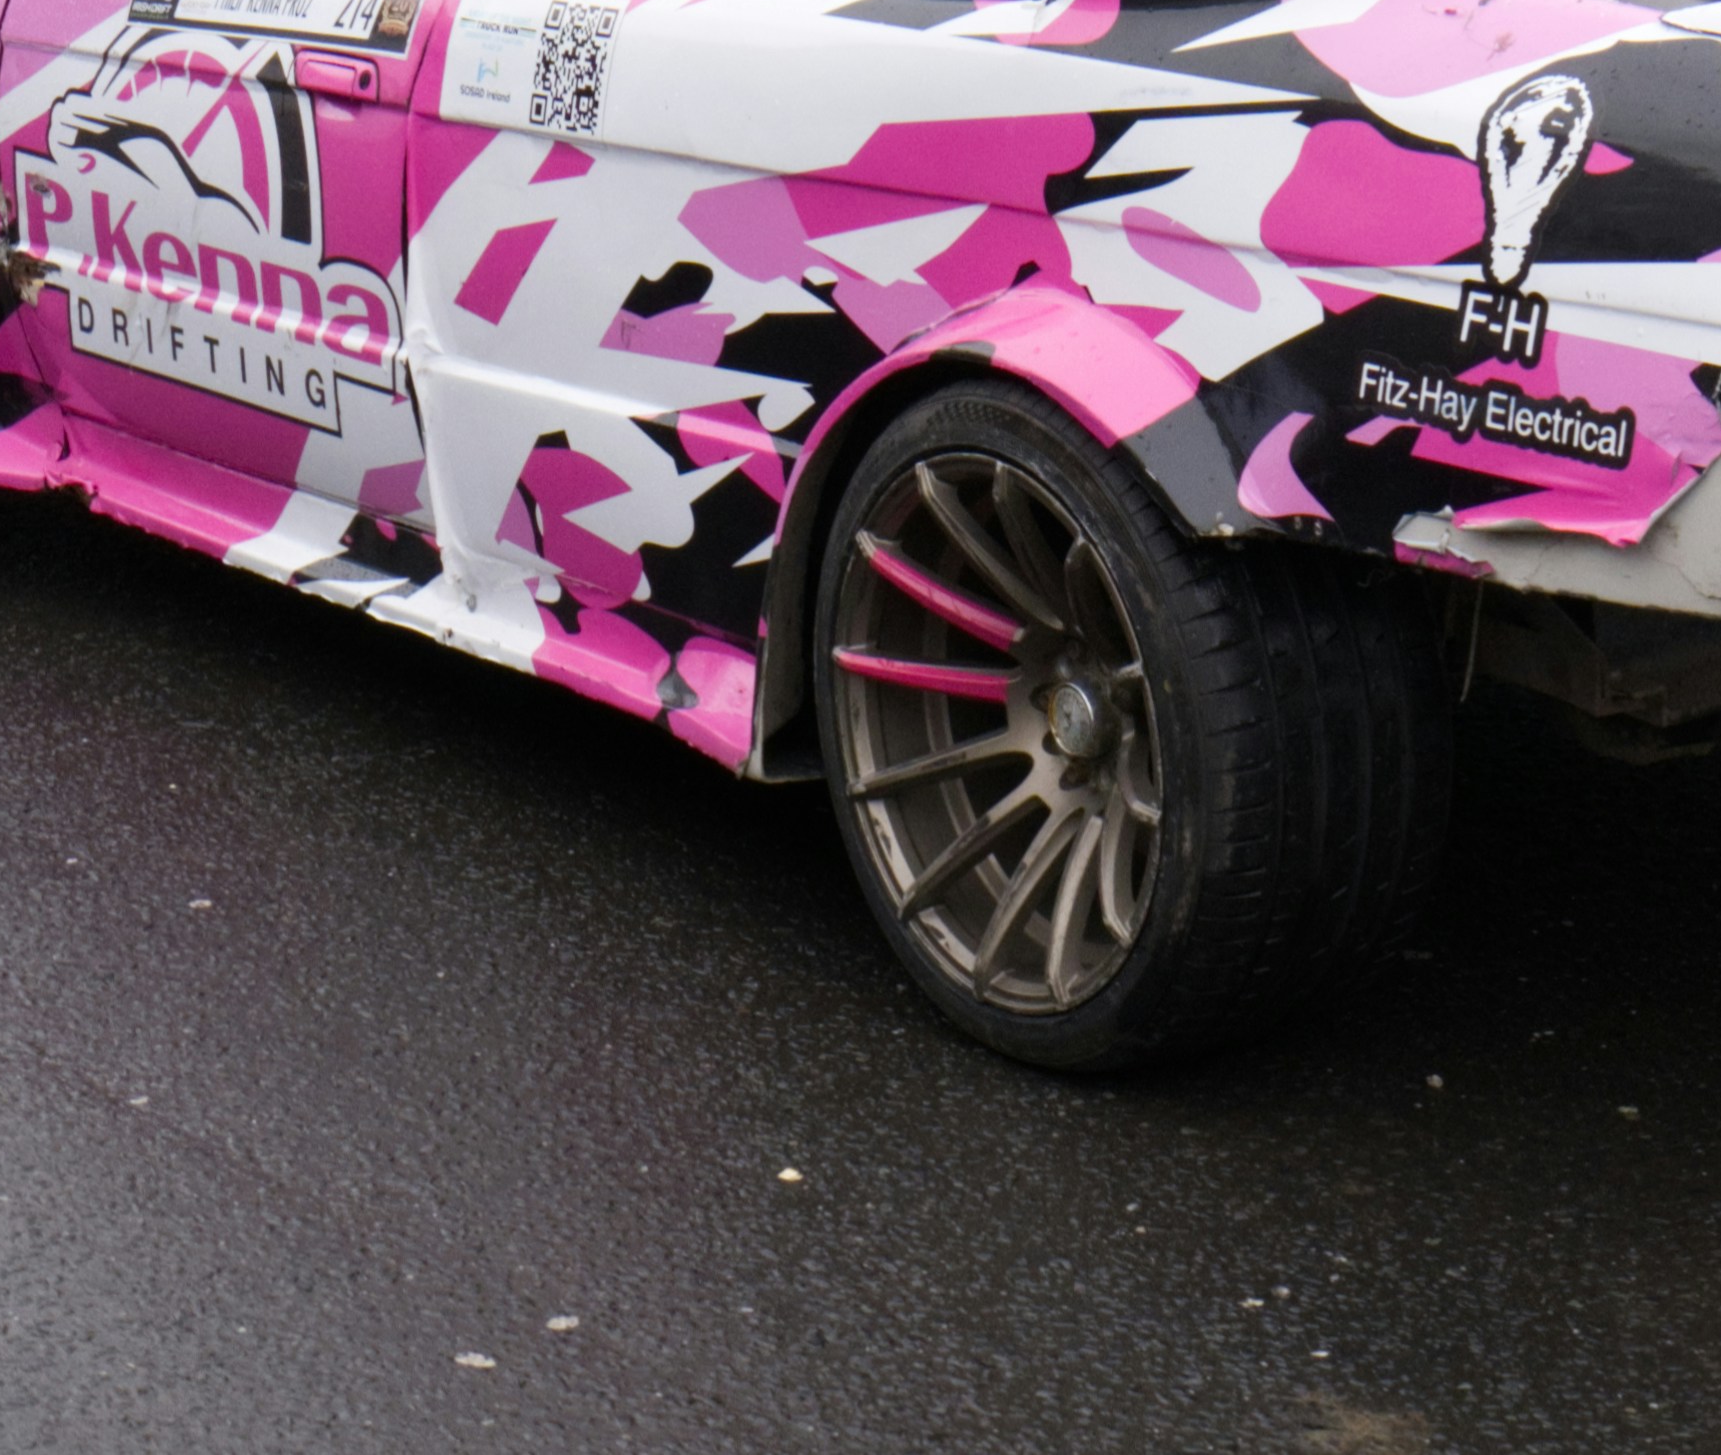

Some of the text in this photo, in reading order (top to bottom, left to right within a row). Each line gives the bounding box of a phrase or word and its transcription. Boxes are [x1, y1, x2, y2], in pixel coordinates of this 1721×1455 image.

[477, 21, 519, 35] TRUCK RUN
[486, 90, 511, 103] Ireland
[78, 297, 326, 409] DRIFTING
[1460, 291, 1540, 357] F-H
[1359, 362, 1628, 458] Fitz-Hay Electrical
